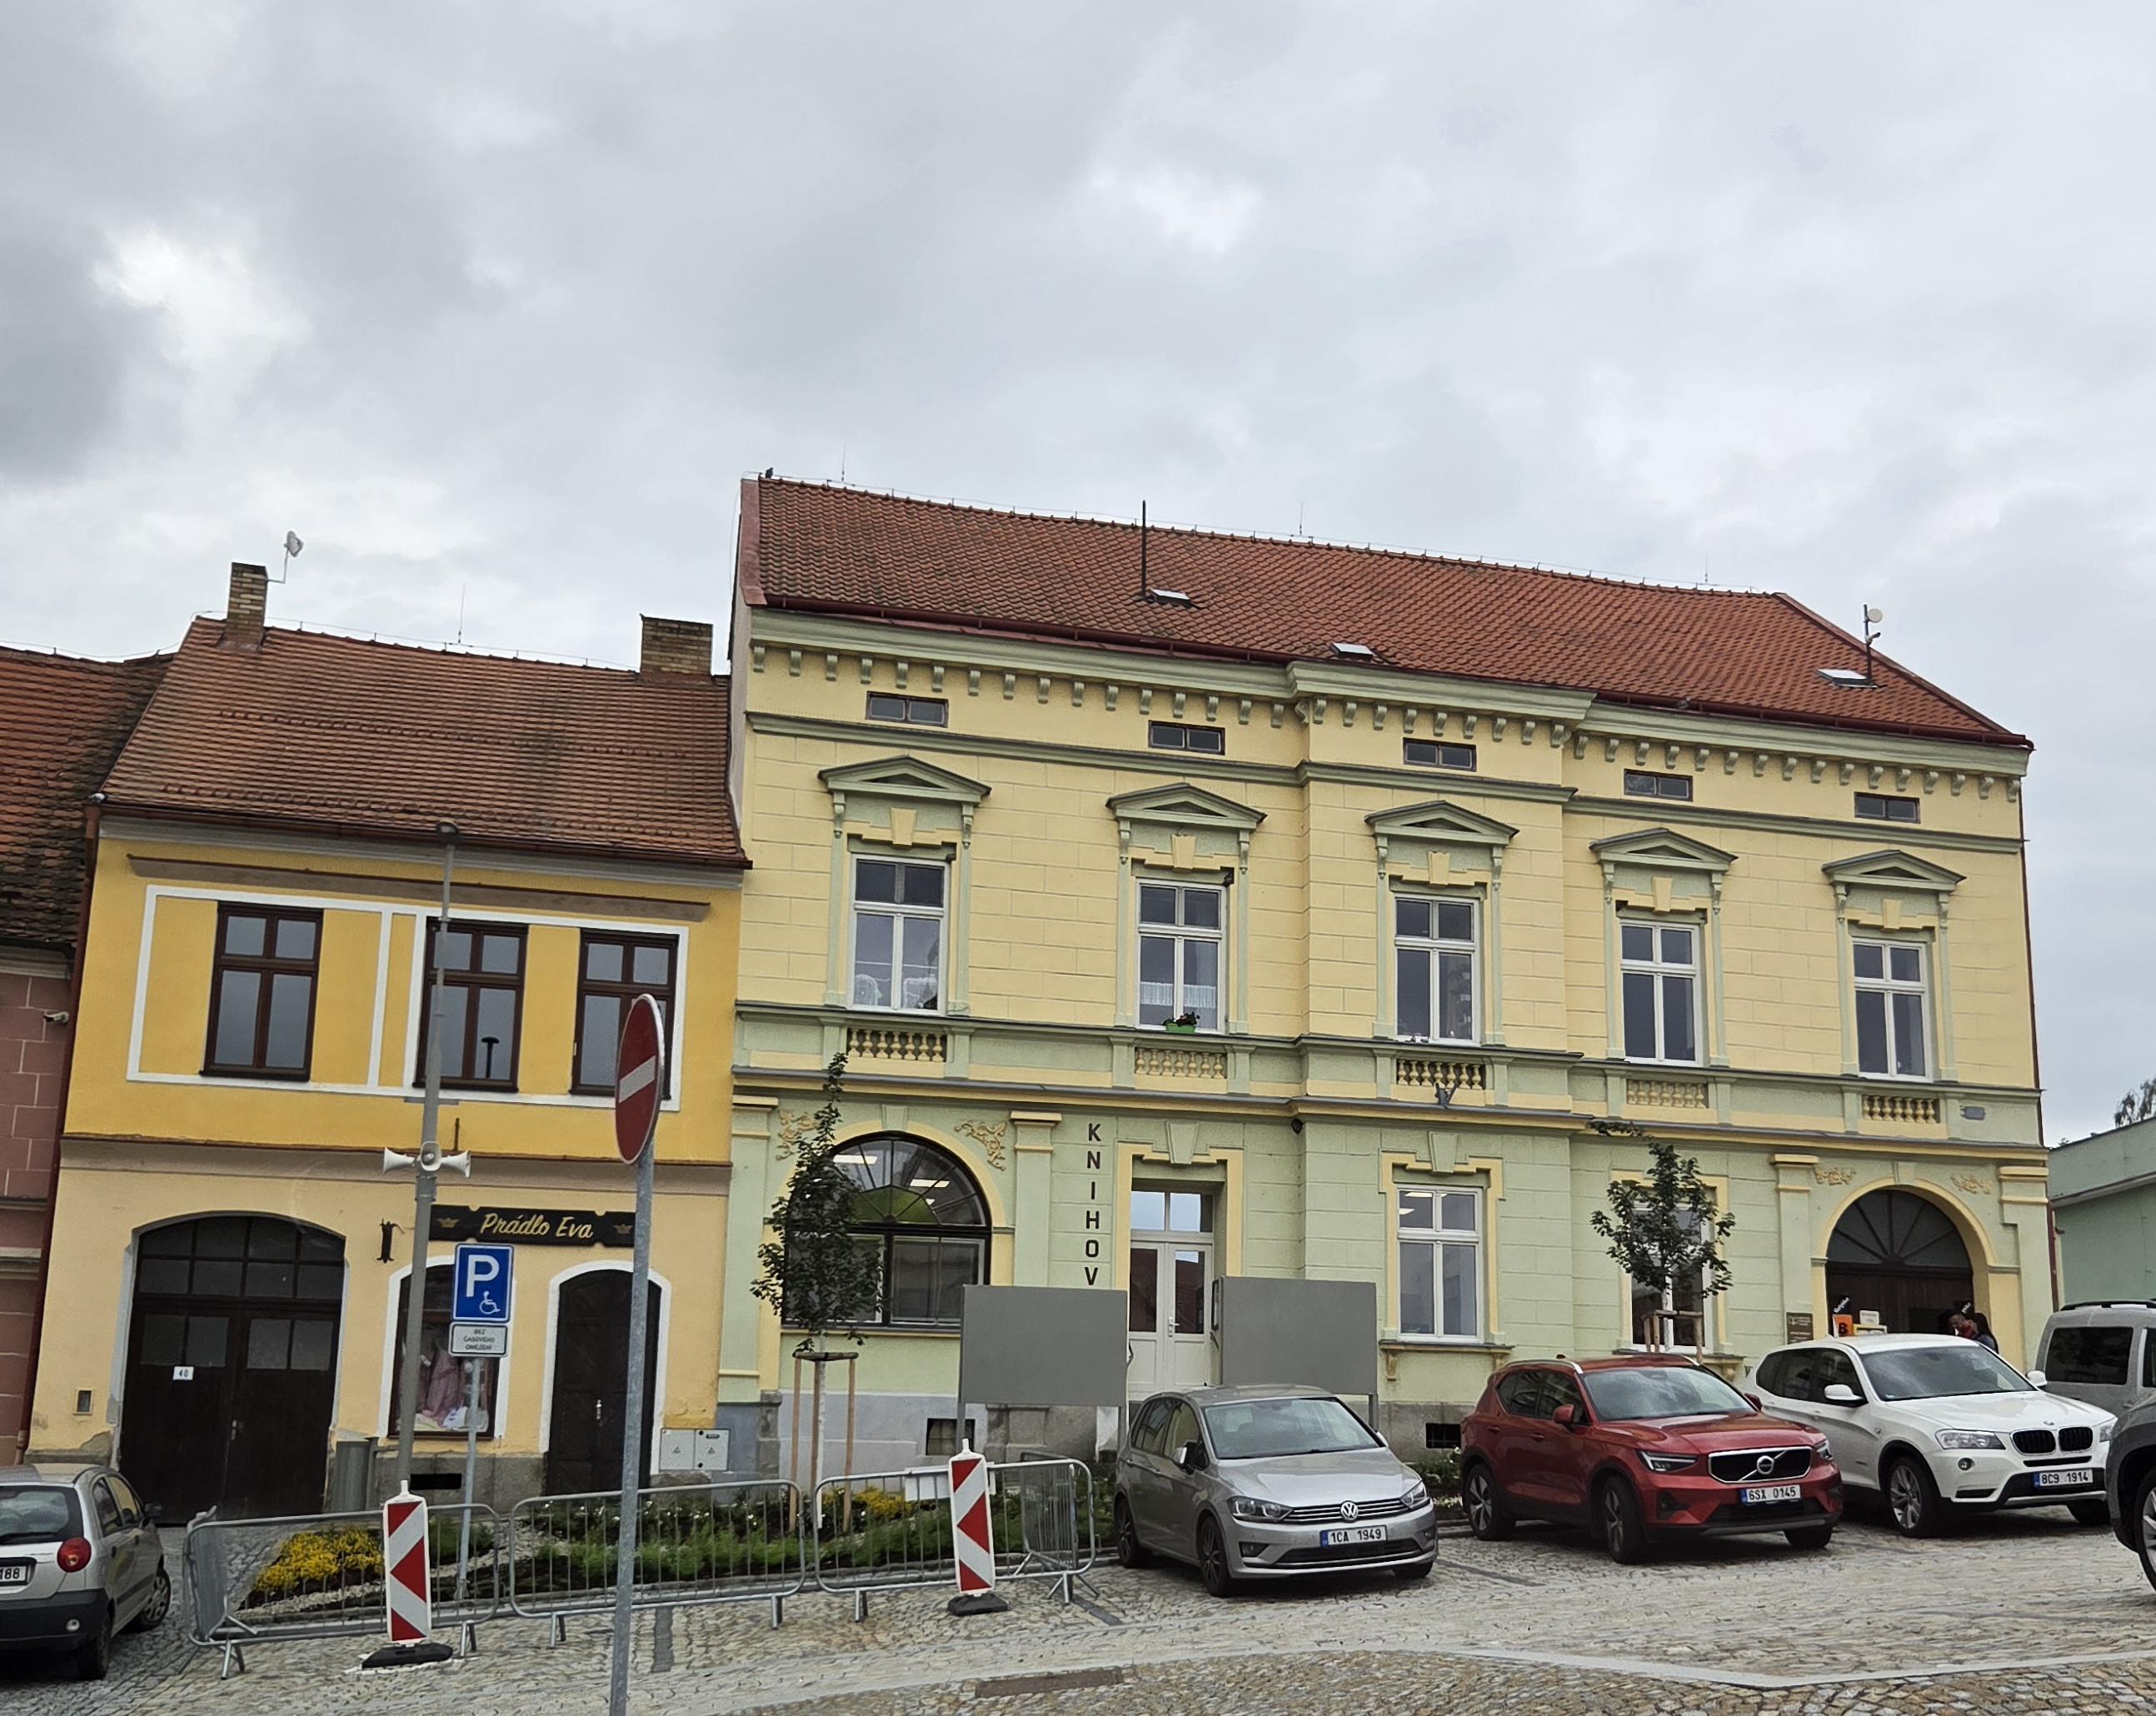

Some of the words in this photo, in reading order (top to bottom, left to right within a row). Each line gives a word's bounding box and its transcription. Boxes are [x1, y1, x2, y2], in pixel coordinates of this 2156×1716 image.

[480, 1213, 551, 1235] Prádlo
[556, 1216, 594, 1239] Eva
[466, 1255, 500, 1297] P
[2042, 1474, 2059, 1484] 8C9
[2066, 1471, 2089, 1483] 1914
[1749, 1489, 1767, 1500] 6SX
[1773, 1487, 1797, 1499] 0145
[1330, 1531, 1350, 1543] 1CA
[1357, 1528, 1382, 1541] 1949
